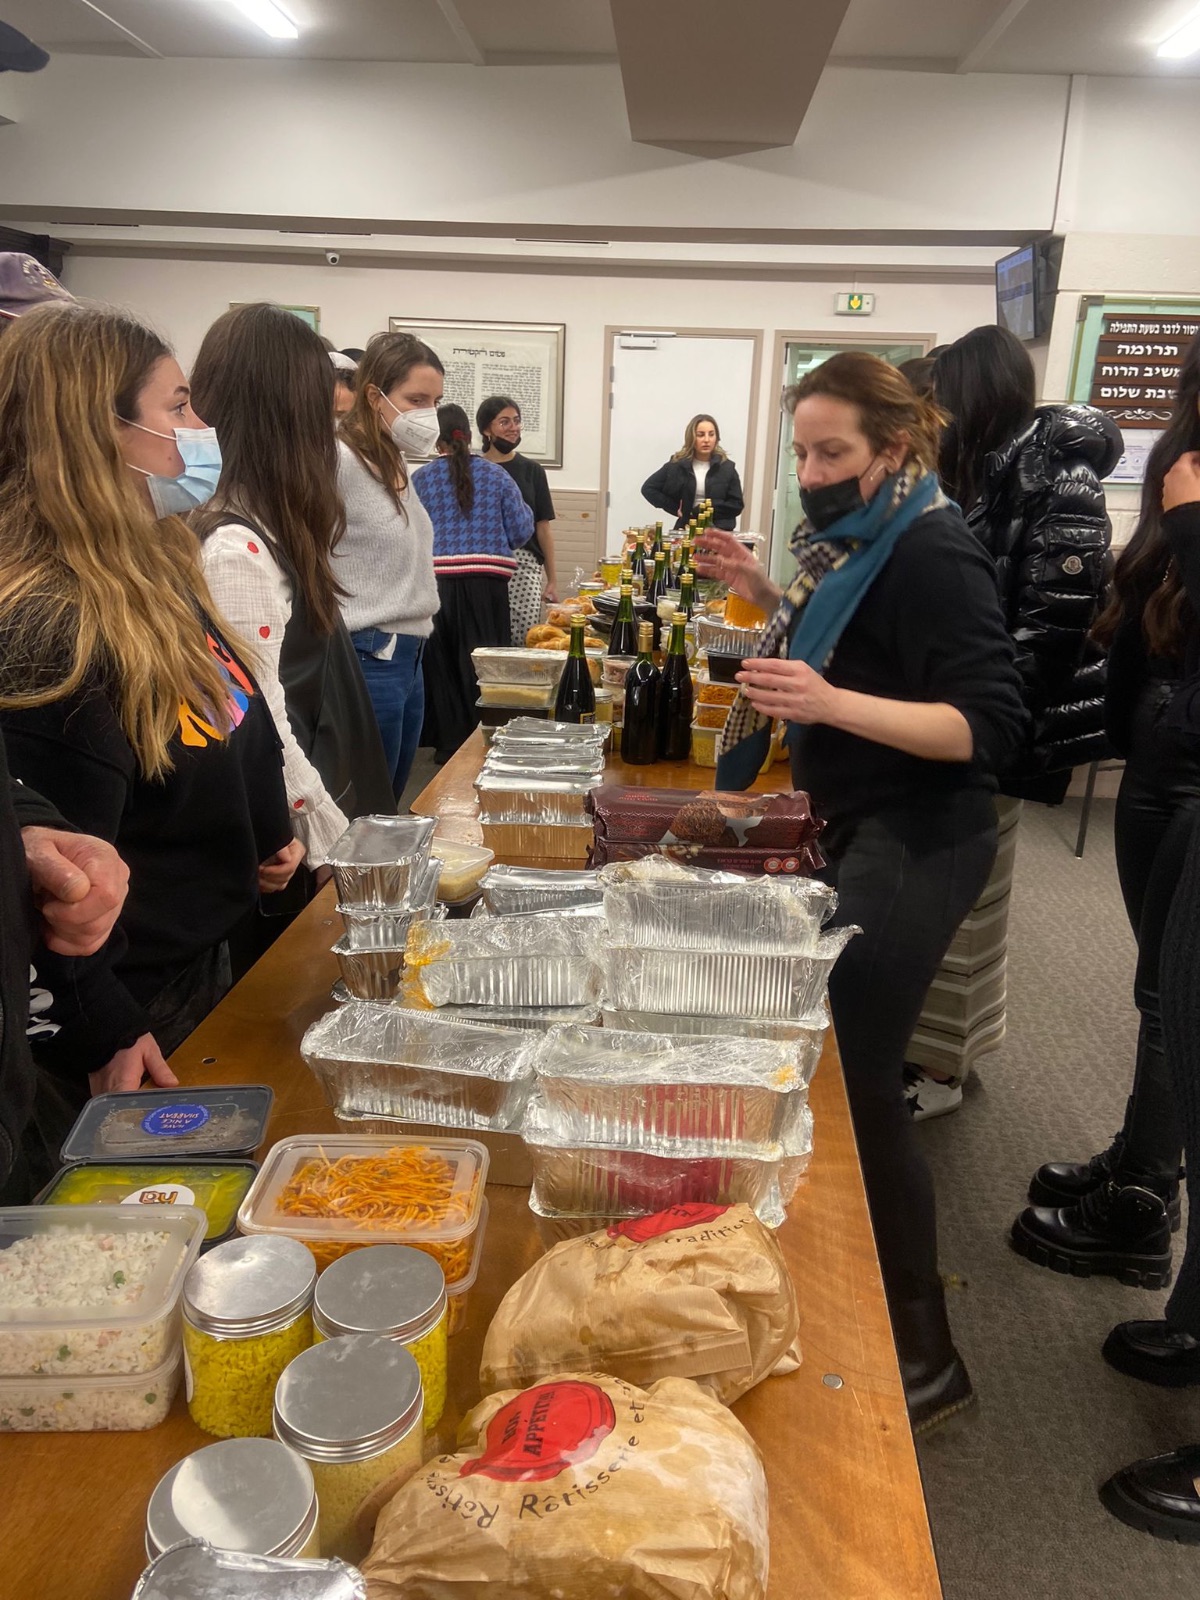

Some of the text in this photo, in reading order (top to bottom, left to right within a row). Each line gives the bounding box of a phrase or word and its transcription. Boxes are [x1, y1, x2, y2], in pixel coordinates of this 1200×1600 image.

[1138, 324, 1160, 335] בשעת
[1162, 323, 1181, 335] לדבר
[1117, 344, 1178, 355] תרומה
[1102, 366, 1139, 376] הרוח
[1100, 385, 1141, 398] שלום
[518, 1434, 641, 1520] Rôtisserie
[628, 1401, 646, 1424] et
[419, 1470, 500, 1530] Rôtiser
